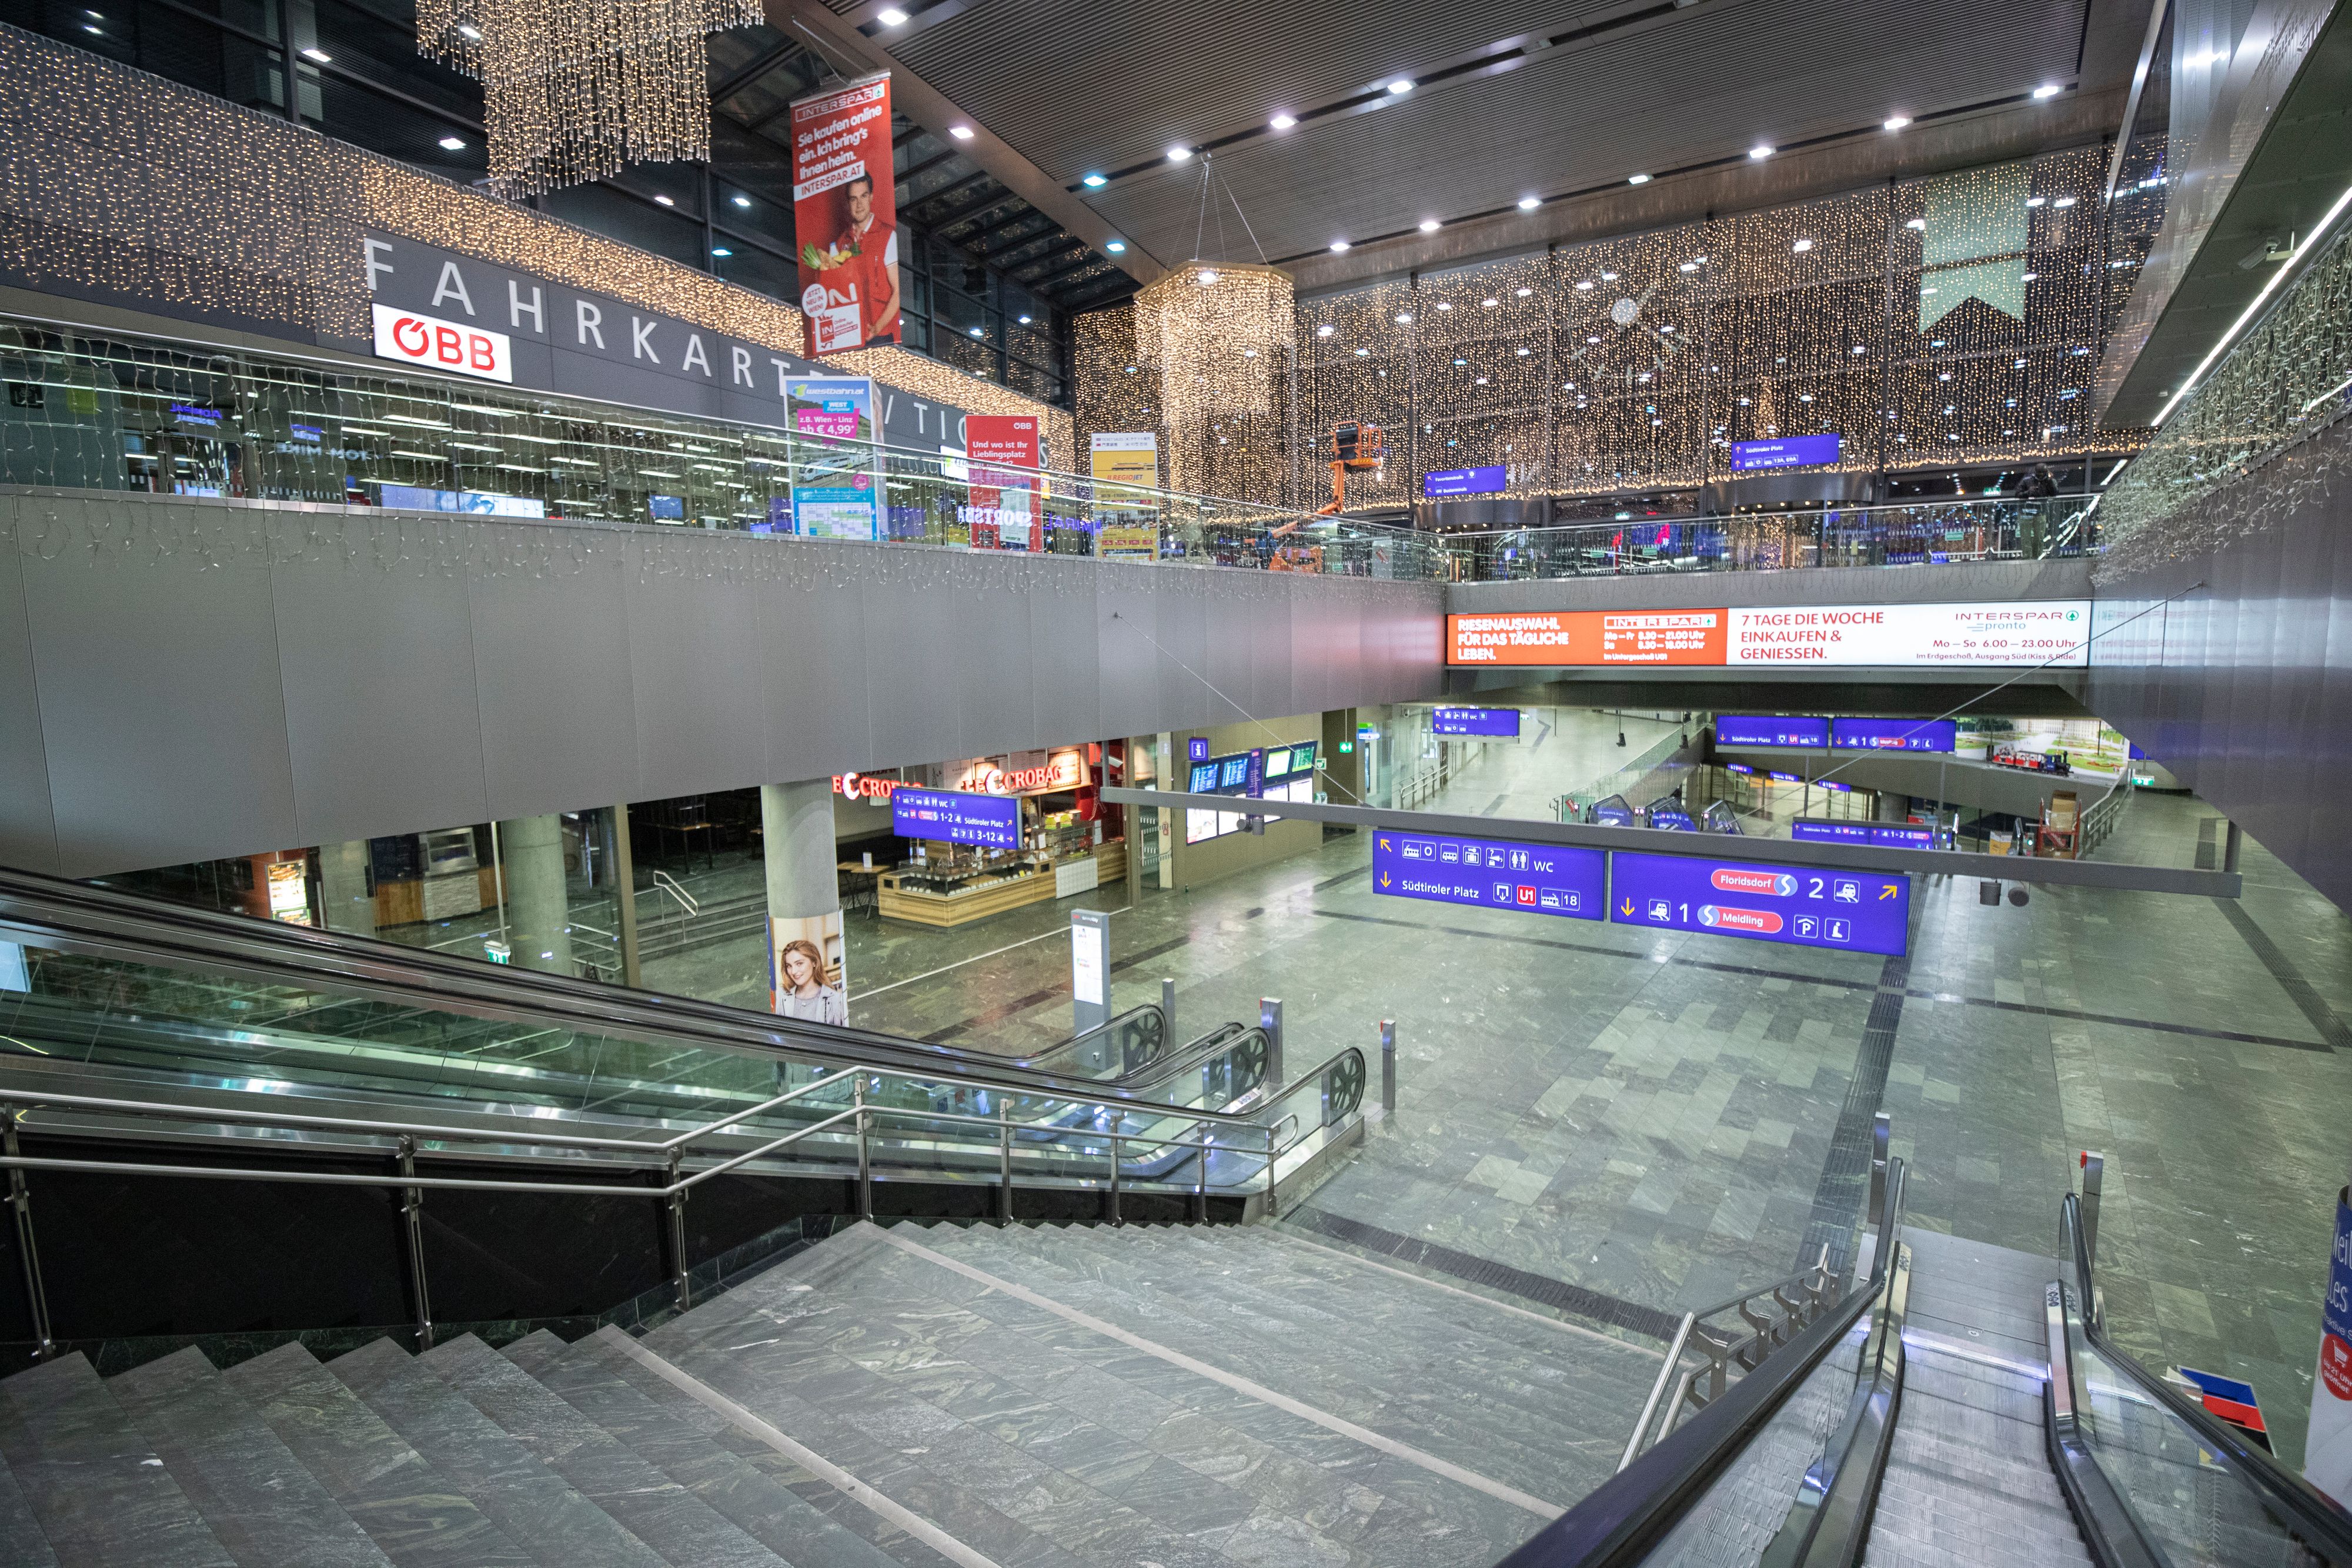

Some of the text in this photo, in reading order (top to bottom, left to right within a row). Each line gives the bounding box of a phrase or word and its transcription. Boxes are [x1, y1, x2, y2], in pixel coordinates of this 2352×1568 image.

[803, 91, 873, 118] INTERSPAR
[798, 105, 883, 147] Sie kaufen online
[799, 149, 817, 163] ein.
[817, 141, 832, 156] Ich
[800, 151, 857, 180] Ihnen heim.
[801, 165, 861, 195] INTERSPAR.AT
[807, 287, 821, 299] JETZT
[806, 297, 817, 306] NEU
[808, 304, 824, 314] WIEN!
[363, 237, 823, 397] FAHRKART
[821, 325, 833, 335] IN
[800, 424, 814, 433] ab
[816, 425, 825, 434] €
[1613, 617, 1701, 627] INTERSPAR
[1742, 612, 1884, 626] 7 TAGE DIE WOCHE
[1956, 612, 2063, 620] INTERSPAR
[1458, 617, 1561, 631] RIESENAUSWAHL
[1985, 621, 2026, 631] pronto
[1458, 630, 1569, 646] FÜR DAS TÄGLICHE
[1604, 631, 1618, 640] Mo
[1626, 631, 1635, 640] Fr
[1638, 631, 1657, 640] 8.30
[1665, 631, 1688, 640] 21.00
[1689, 630, 1706, 640] Uhr
[1741, 630, 1842, 643] EINKAUFEN &
[1604, 641, 1615, 650] Sa
[1638, 641, 1657, 650] 8.30
[1689, 640, 1705, 650] Uhr
[2056, 639, 2077, 647] Uhr
[1458, 647, 1496, 660] LEBEN.
[1612, 653, 1655, 661] Untergeschoß
[1740, 647, 1828, 660] GENIESSEN.
[1927, 653, 1973, 661] Erdgeschoß,
[1862, 737, 1866, 746] 1
[1004, 765, 1063, 791] CROBAG
[859, 776, 923, 799] CRO
[940, 813, 953, 823] 1-2
[964, 817, 990, 827] Südtiroler
[977, 830, 995, 842] 3-12
[1534, 860, 1553, 873] WC
[1402, 880, 1577, 906] Südtiroler Platz U1 18
[1720, 874, 1772, 888] Floridsdorf
[1809, 878, 1823, 899] 2
[1679, 903, 1688, 923] 1
[1722, 912, 1763, 927] Meidling
[2324, 1369, 2349, 1394] geöffnet
[2330, 1366, 2338, 1376] 21
[2340, 1373, 2352, 1388] Uhr
